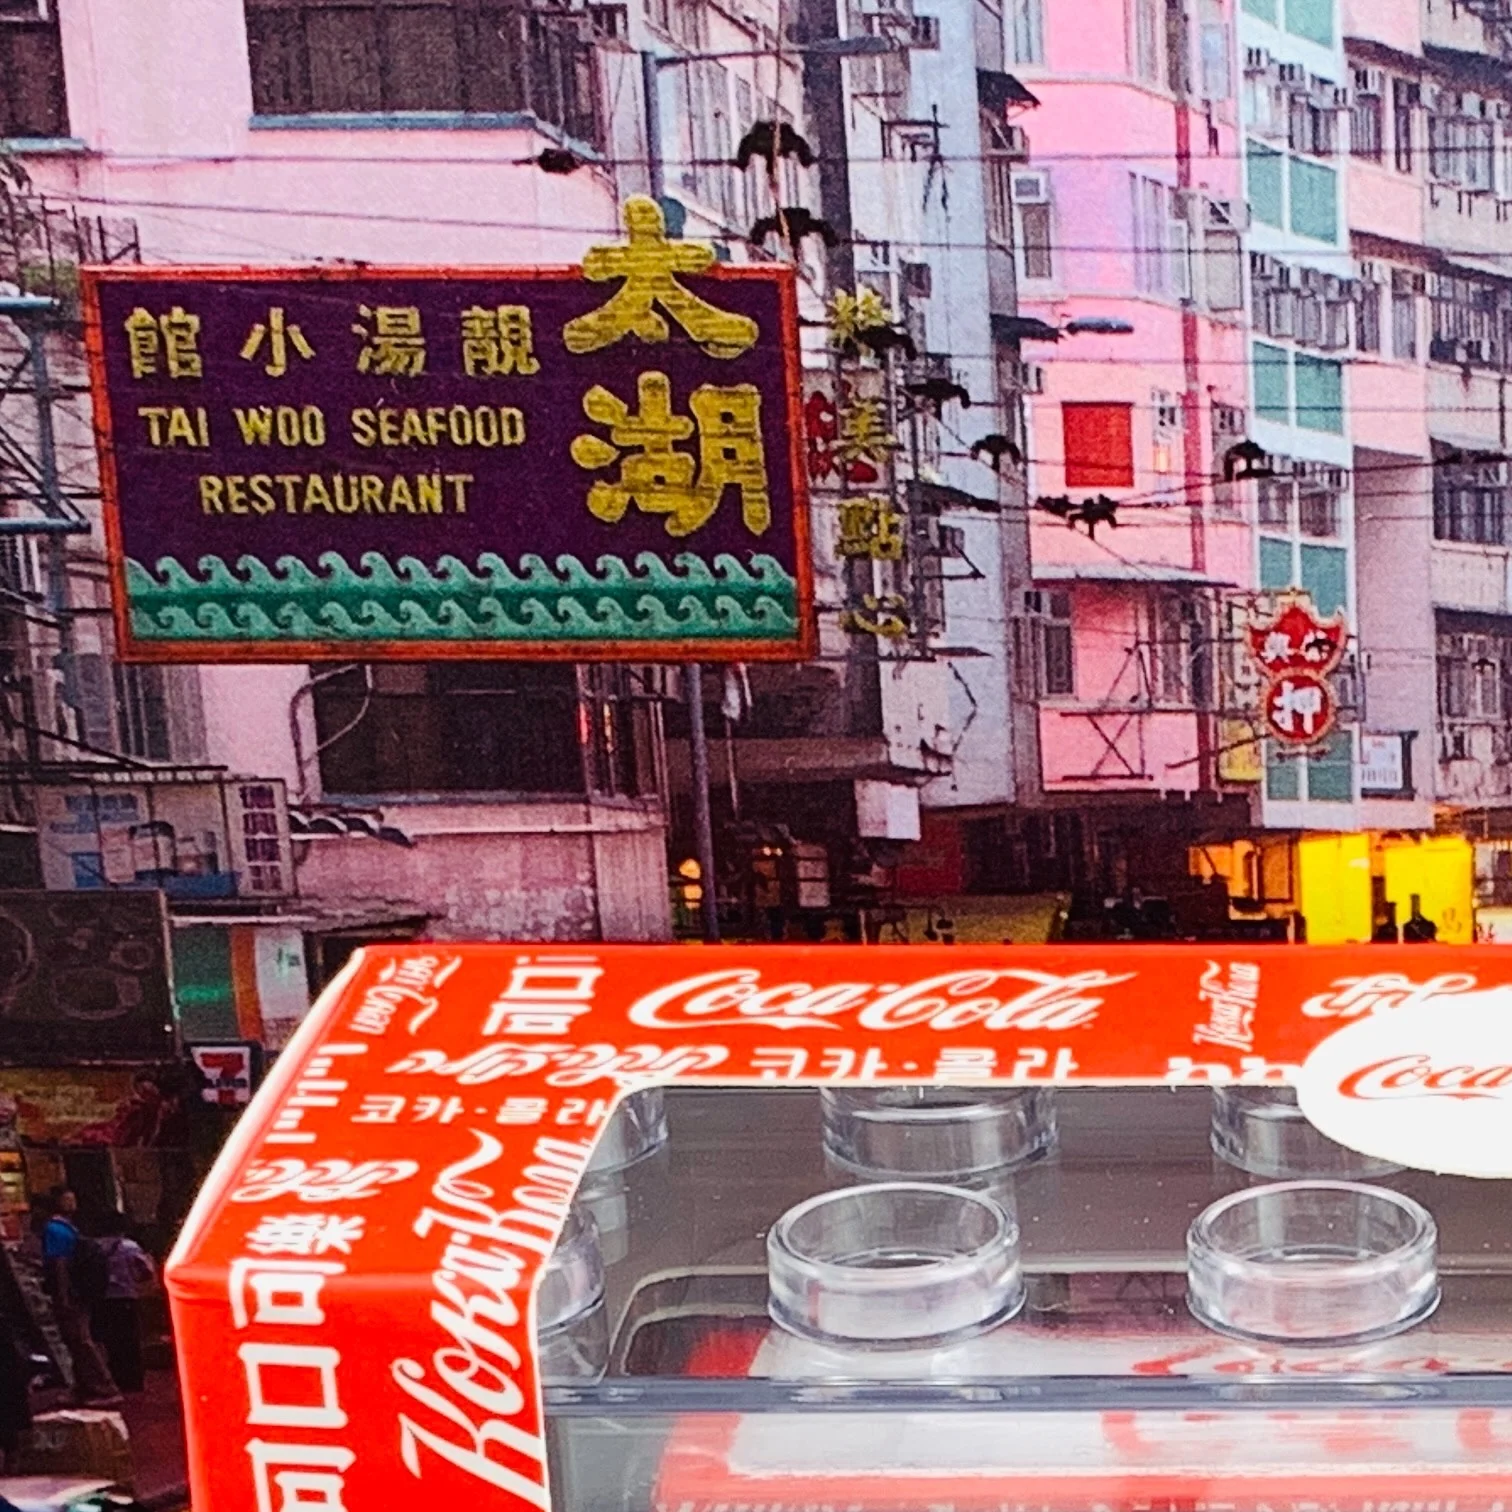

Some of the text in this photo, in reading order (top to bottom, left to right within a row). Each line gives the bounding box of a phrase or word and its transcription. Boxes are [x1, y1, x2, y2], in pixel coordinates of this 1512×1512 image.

[139, 404, 526, 448] TAI WOO SEAFOOD
[200, 472, 474, 516] RESTAURANT
[627, 968, 1139, 1032] Coca-Cola
